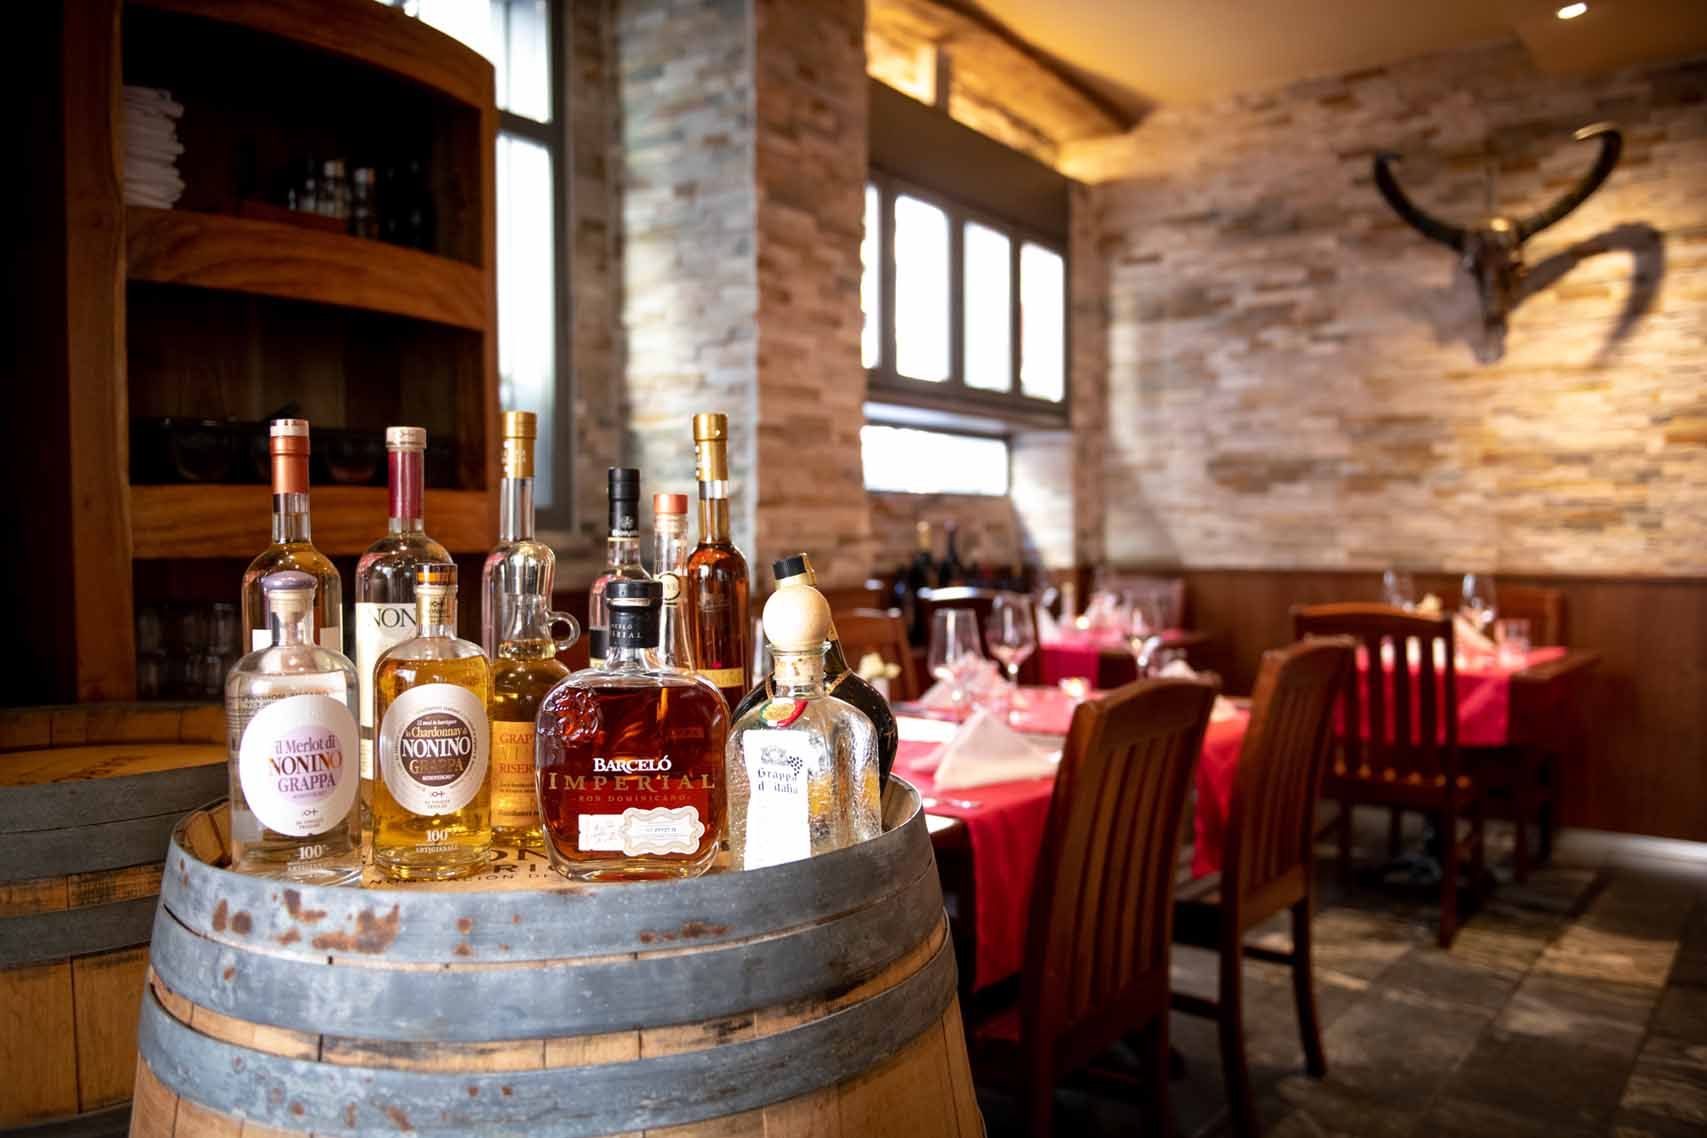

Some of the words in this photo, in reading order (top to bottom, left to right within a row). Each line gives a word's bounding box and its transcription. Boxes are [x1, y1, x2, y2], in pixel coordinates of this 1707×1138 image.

[372, 607, 416, 628] NON
[411, 726, 463, 738] Chardonnay
[500, 733, 534, 745] GRAP
[286, 736, 324, 754] Merlot
[325, 734, 336, 749] di
[402, 736, 471, 758] NONINO
[269, 751, 342, 776] NONINO
[497, 763, 533, 774] RISER
[593, 755, 672, 774] BARCELÓ
[278, 772, 337, 793] GRAPPA
[548, 772, 715, 793] IMPERIAL
